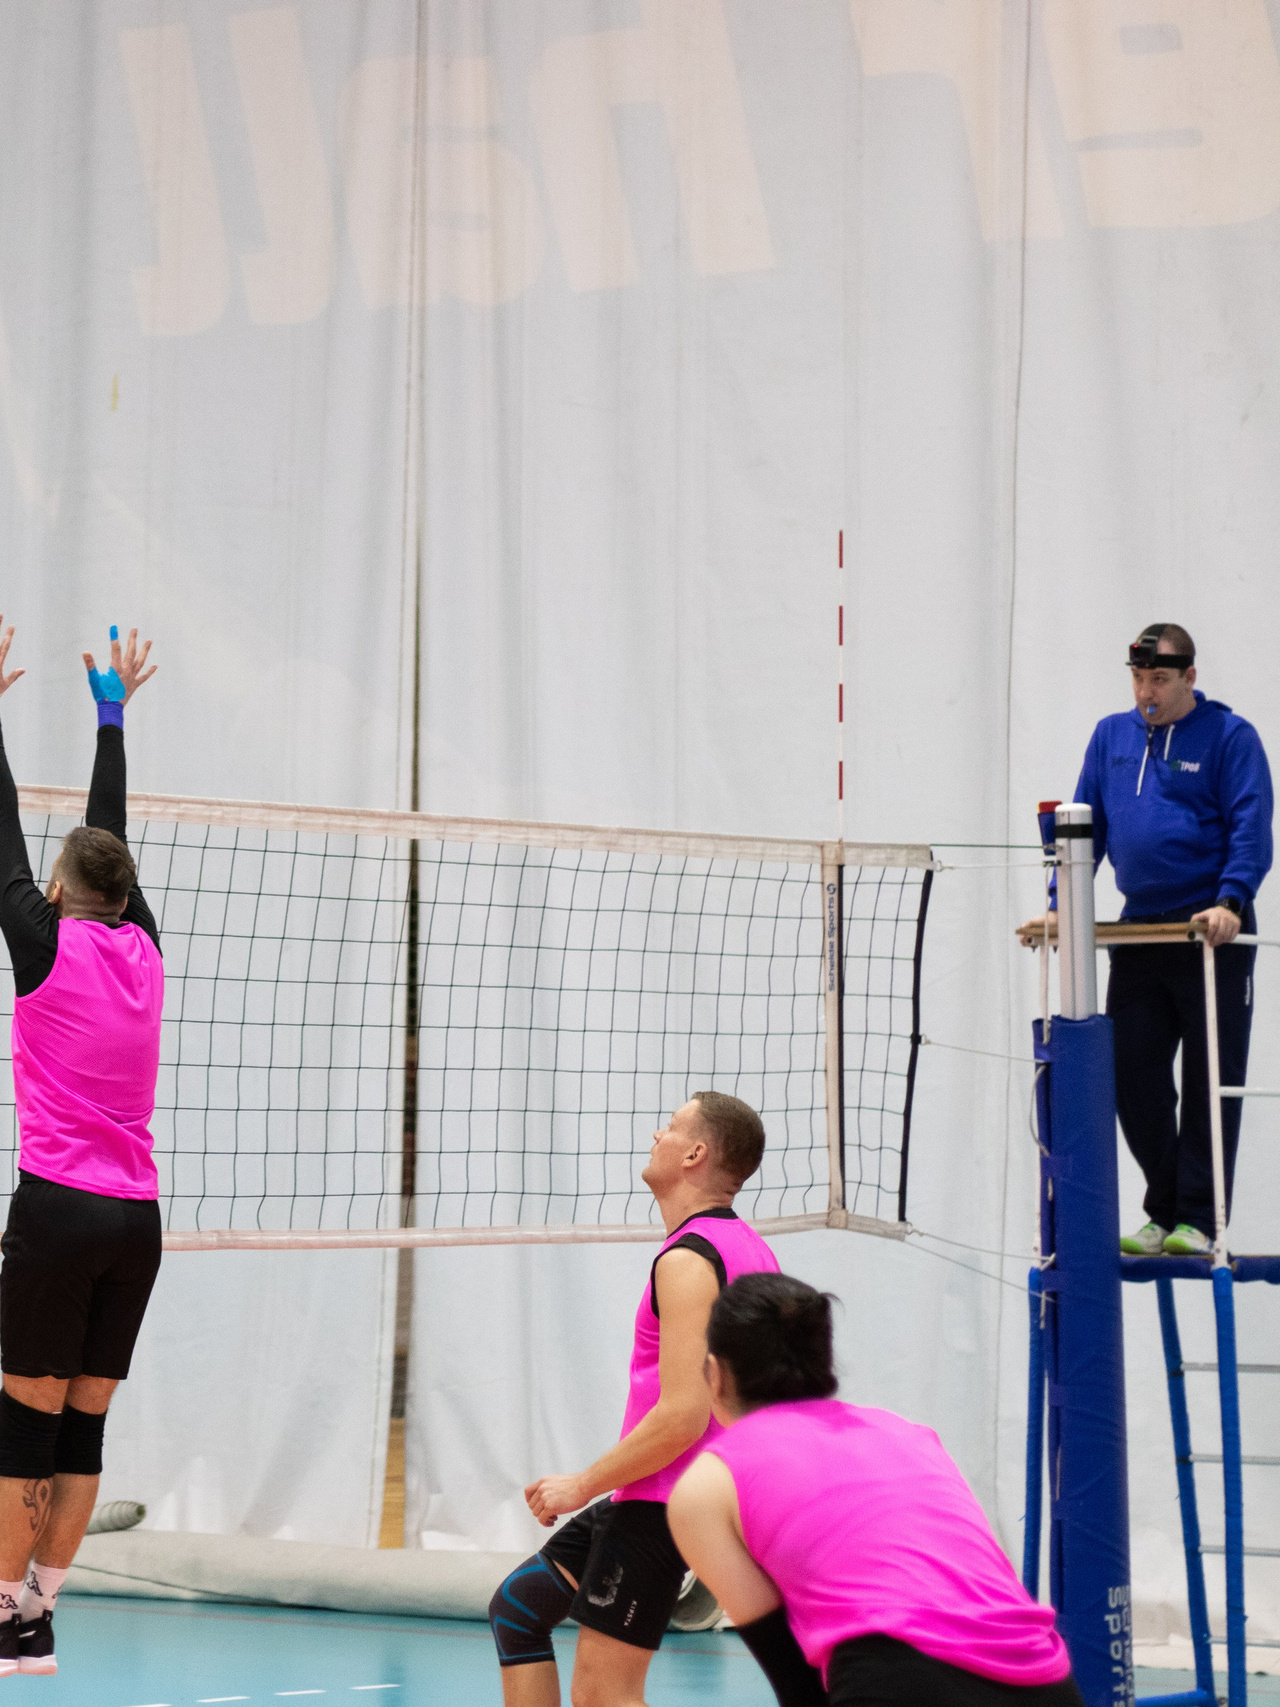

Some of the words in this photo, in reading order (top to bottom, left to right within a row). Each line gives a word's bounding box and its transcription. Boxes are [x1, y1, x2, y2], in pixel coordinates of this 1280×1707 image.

[826, 897, 837, 939] Sports
[826, 941, 837, 992] Schelde
[623, 1600, 638, 1626] KIPSTA
